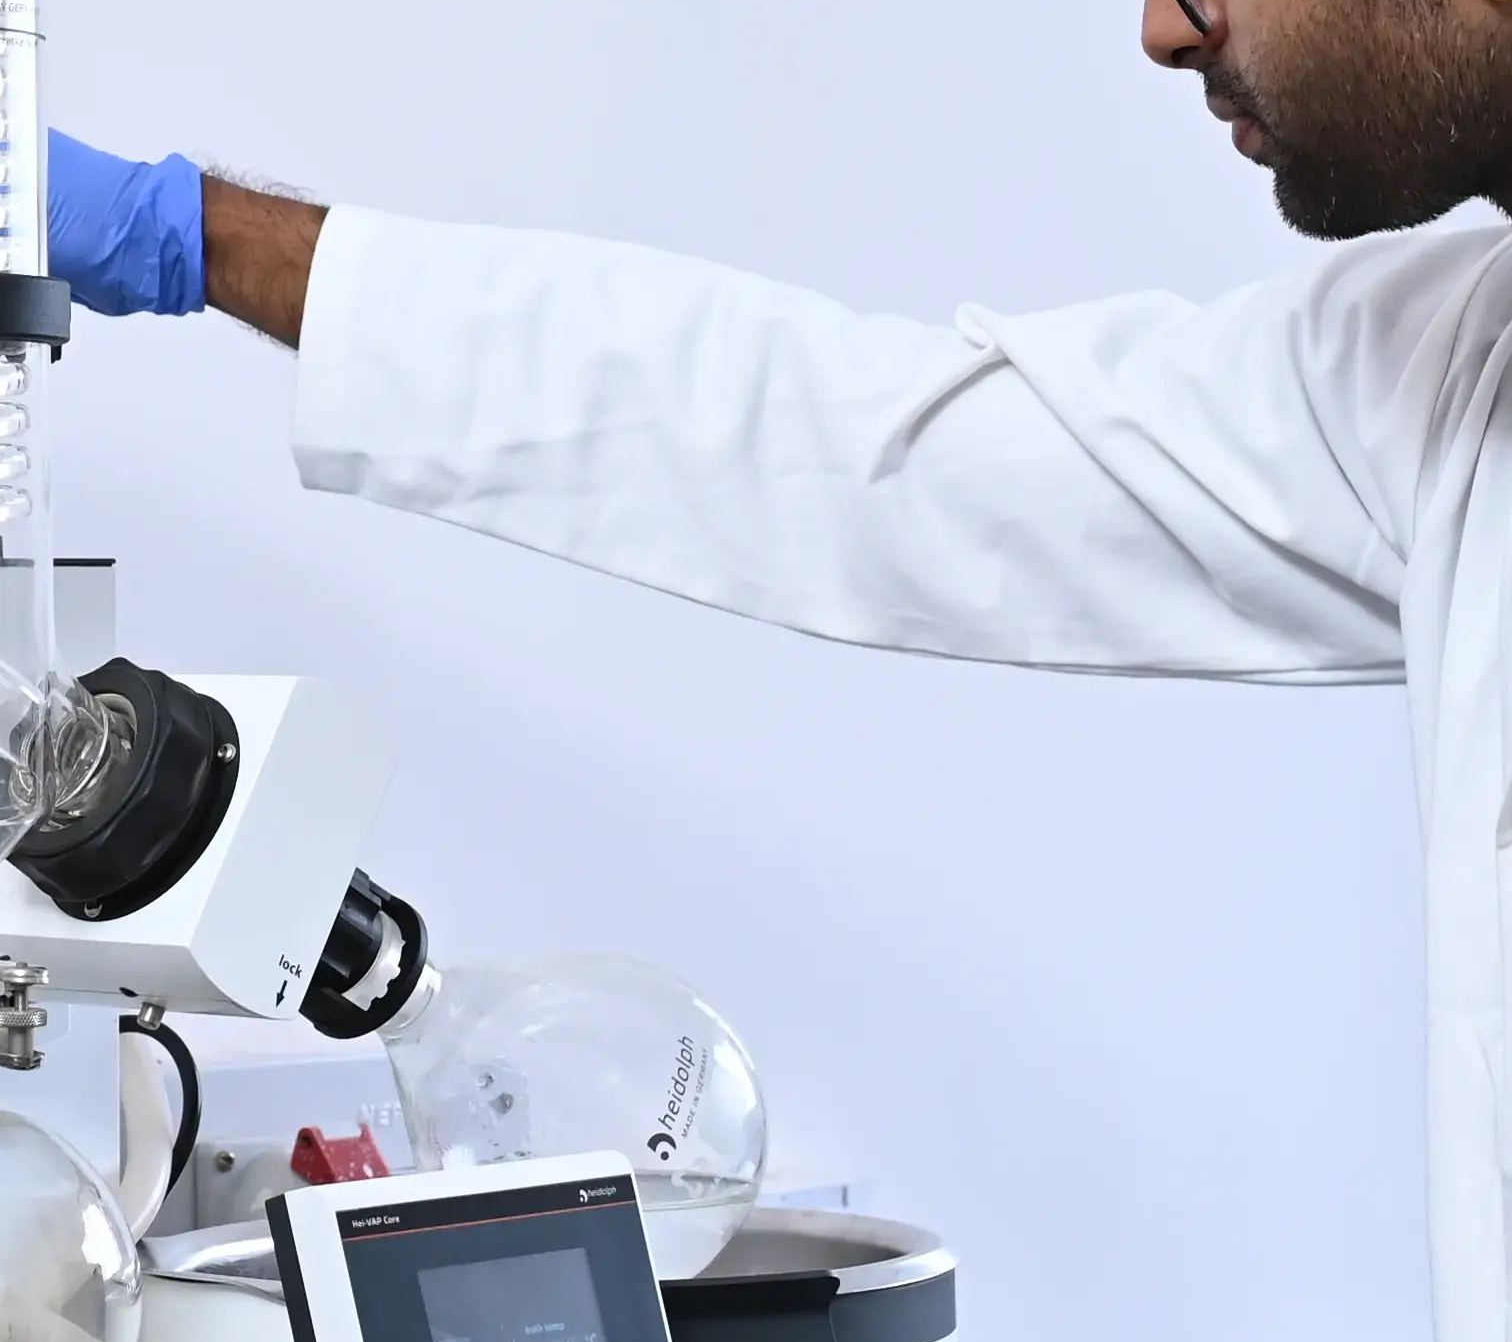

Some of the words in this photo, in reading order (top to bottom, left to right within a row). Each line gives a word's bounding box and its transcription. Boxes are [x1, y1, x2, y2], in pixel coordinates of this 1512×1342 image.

[278, 954, 304, 979] lock
[658, 1034, 695, 1131] heidolph
[680, 1109, 696, 1139] MADE
[692, 1095, 700, 1108] IN
